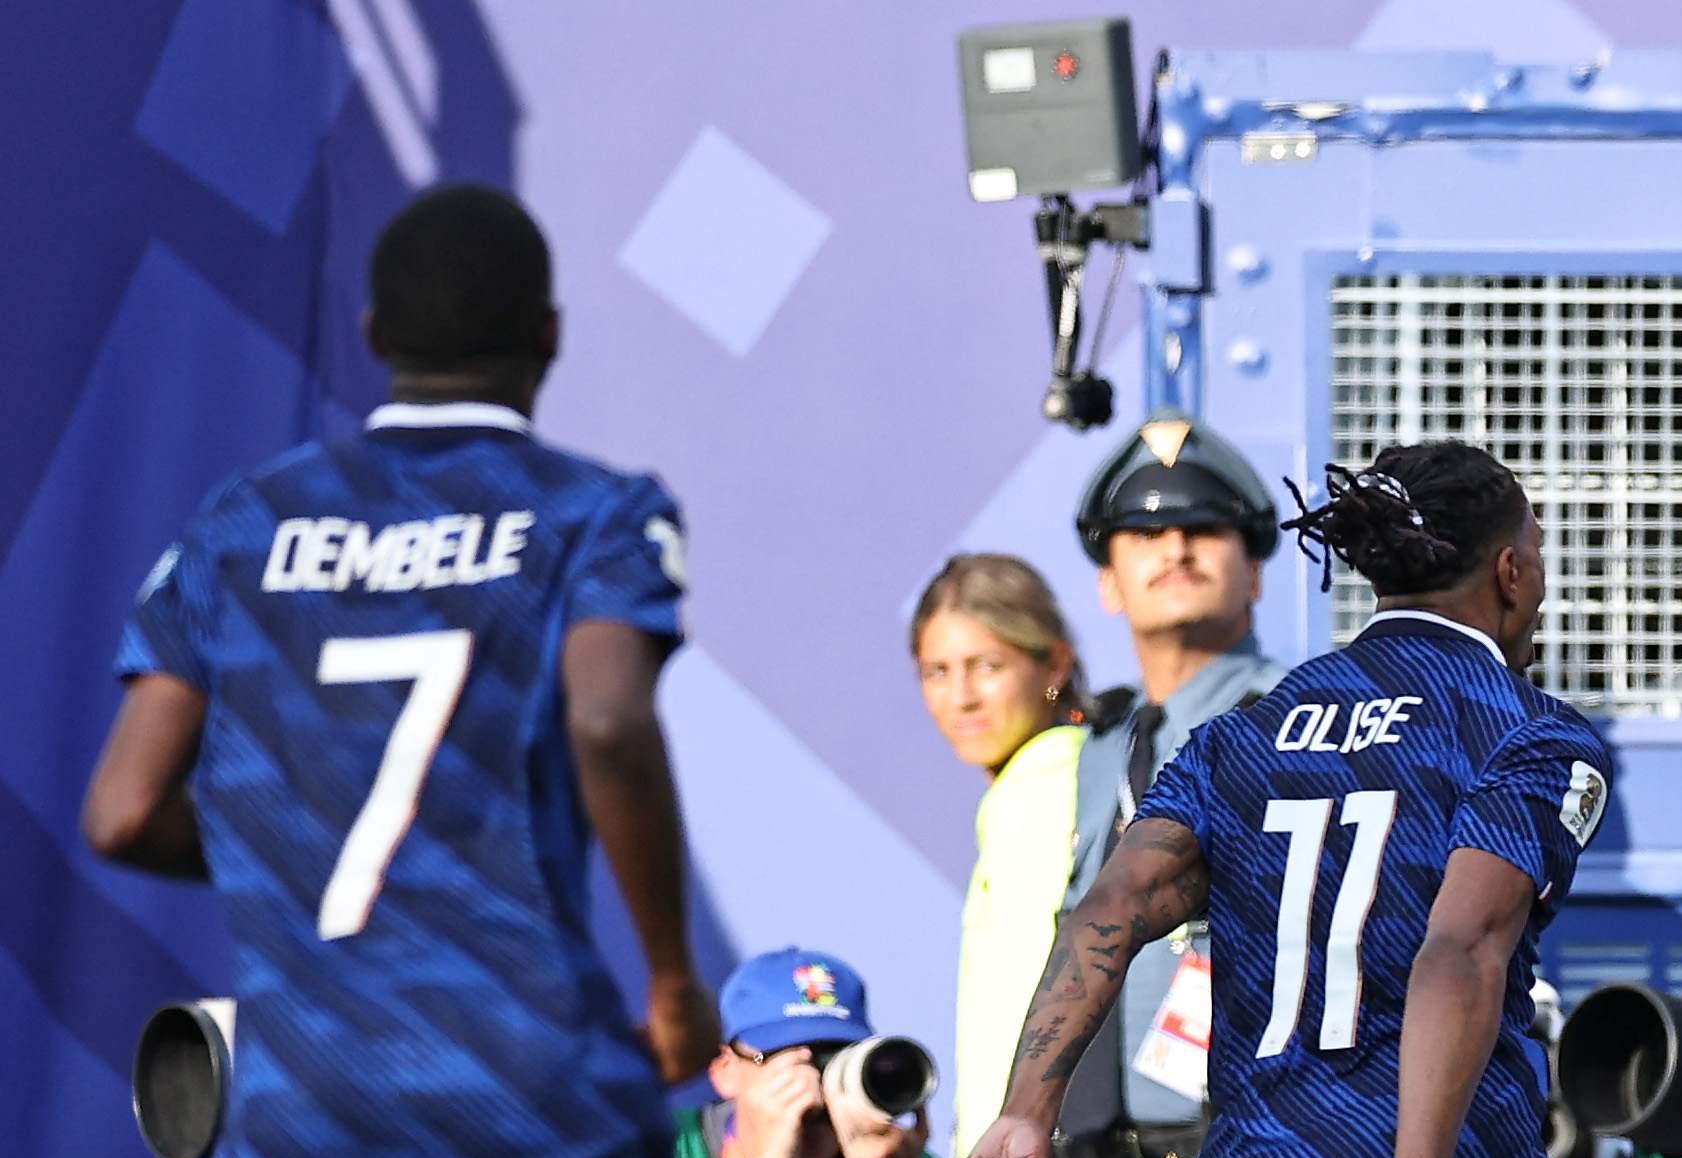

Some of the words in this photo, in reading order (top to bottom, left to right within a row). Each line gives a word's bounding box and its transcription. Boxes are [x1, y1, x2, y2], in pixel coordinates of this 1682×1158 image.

[263, 511, 535, 592] DEMBELE
[317, 629, 475, 941] 7
[1275, 696, 1423, 754] OLISE
[1255, 790, 1398, 1059] 11
